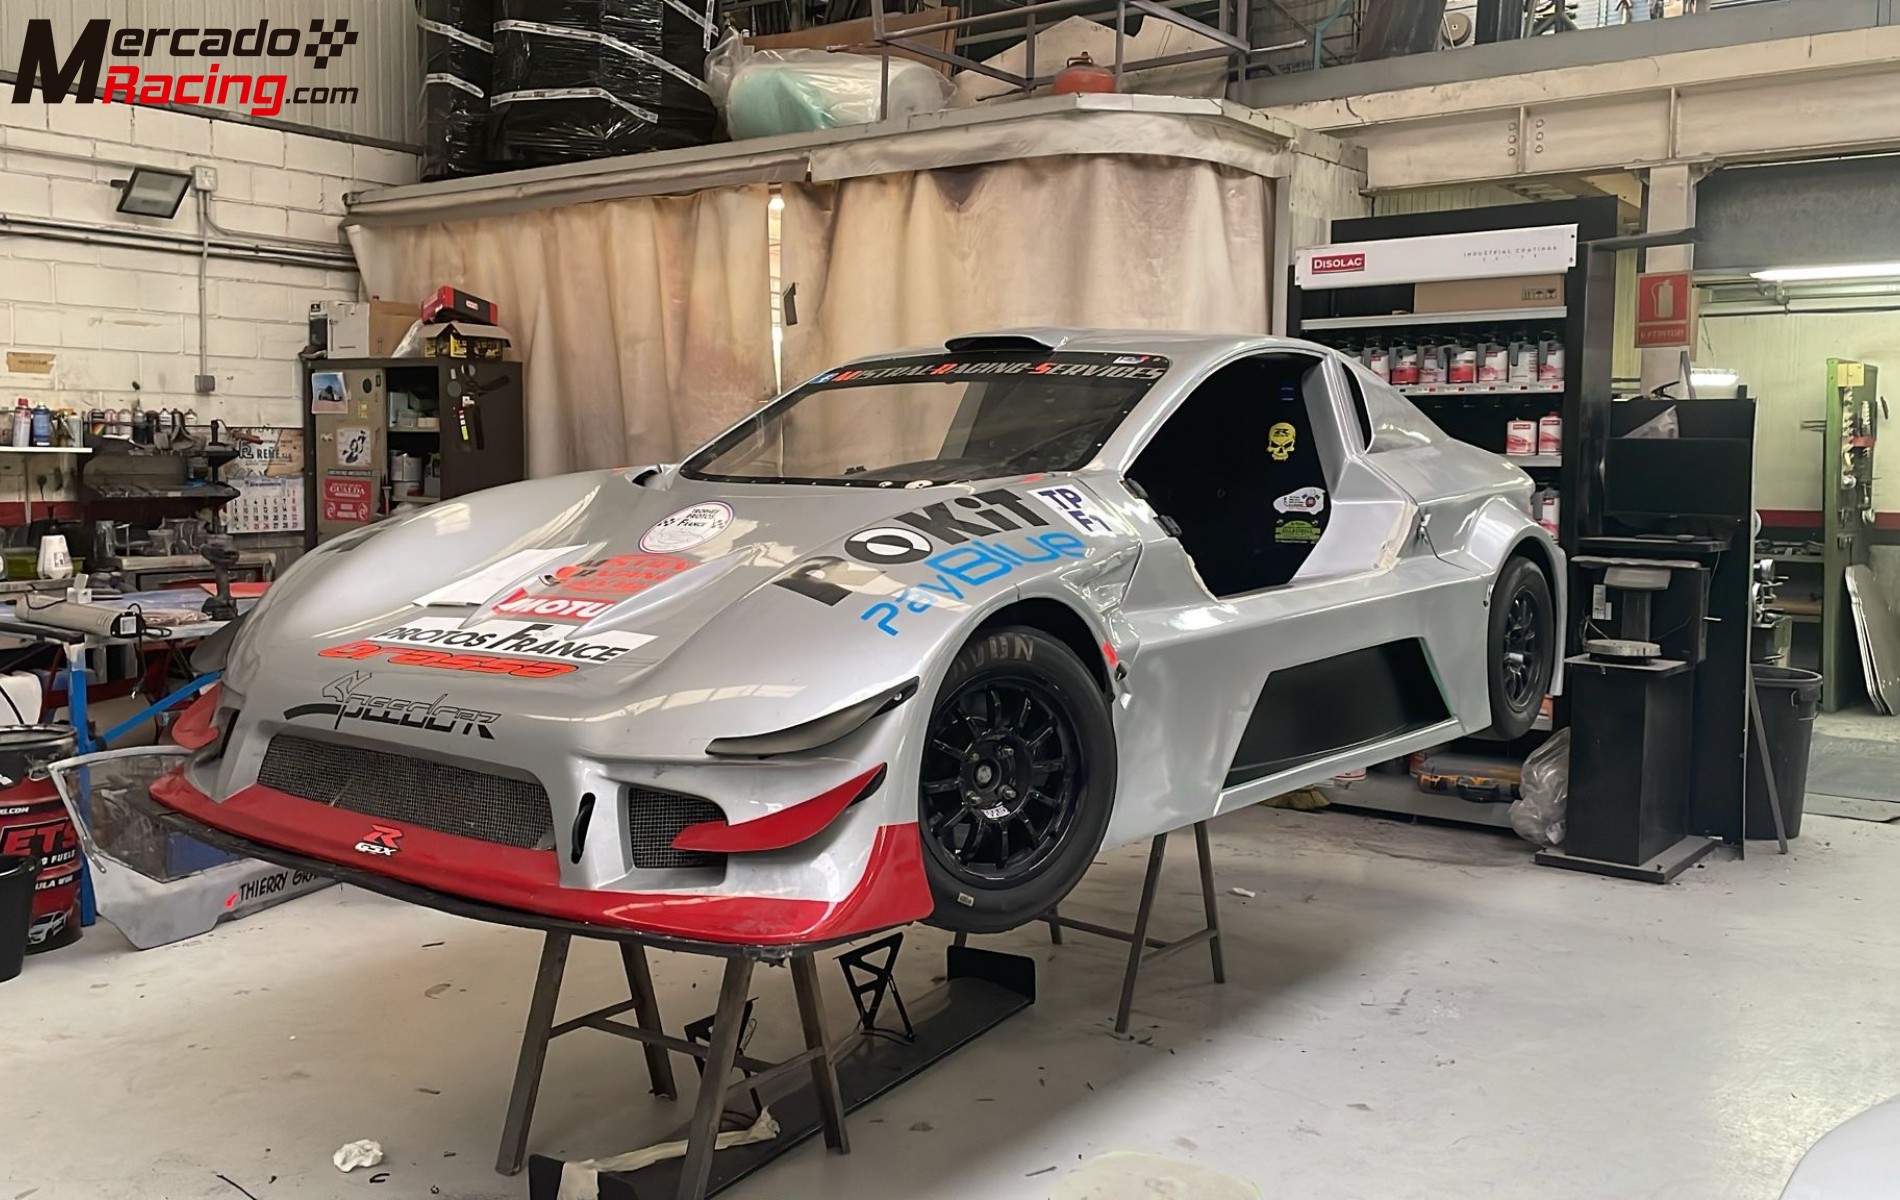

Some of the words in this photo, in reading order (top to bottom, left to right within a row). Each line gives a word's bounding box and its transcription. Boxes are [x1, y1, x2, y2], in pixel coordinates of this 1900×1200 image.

[1314, 257, 1362, 269] DISOLAC
[498, 598, 616, 618] MOTU
[374, 627, 498, 647] PROTOS
[484, 623, 632, 664] FRANCE
[240, 871, 289, 901] THIERRY
